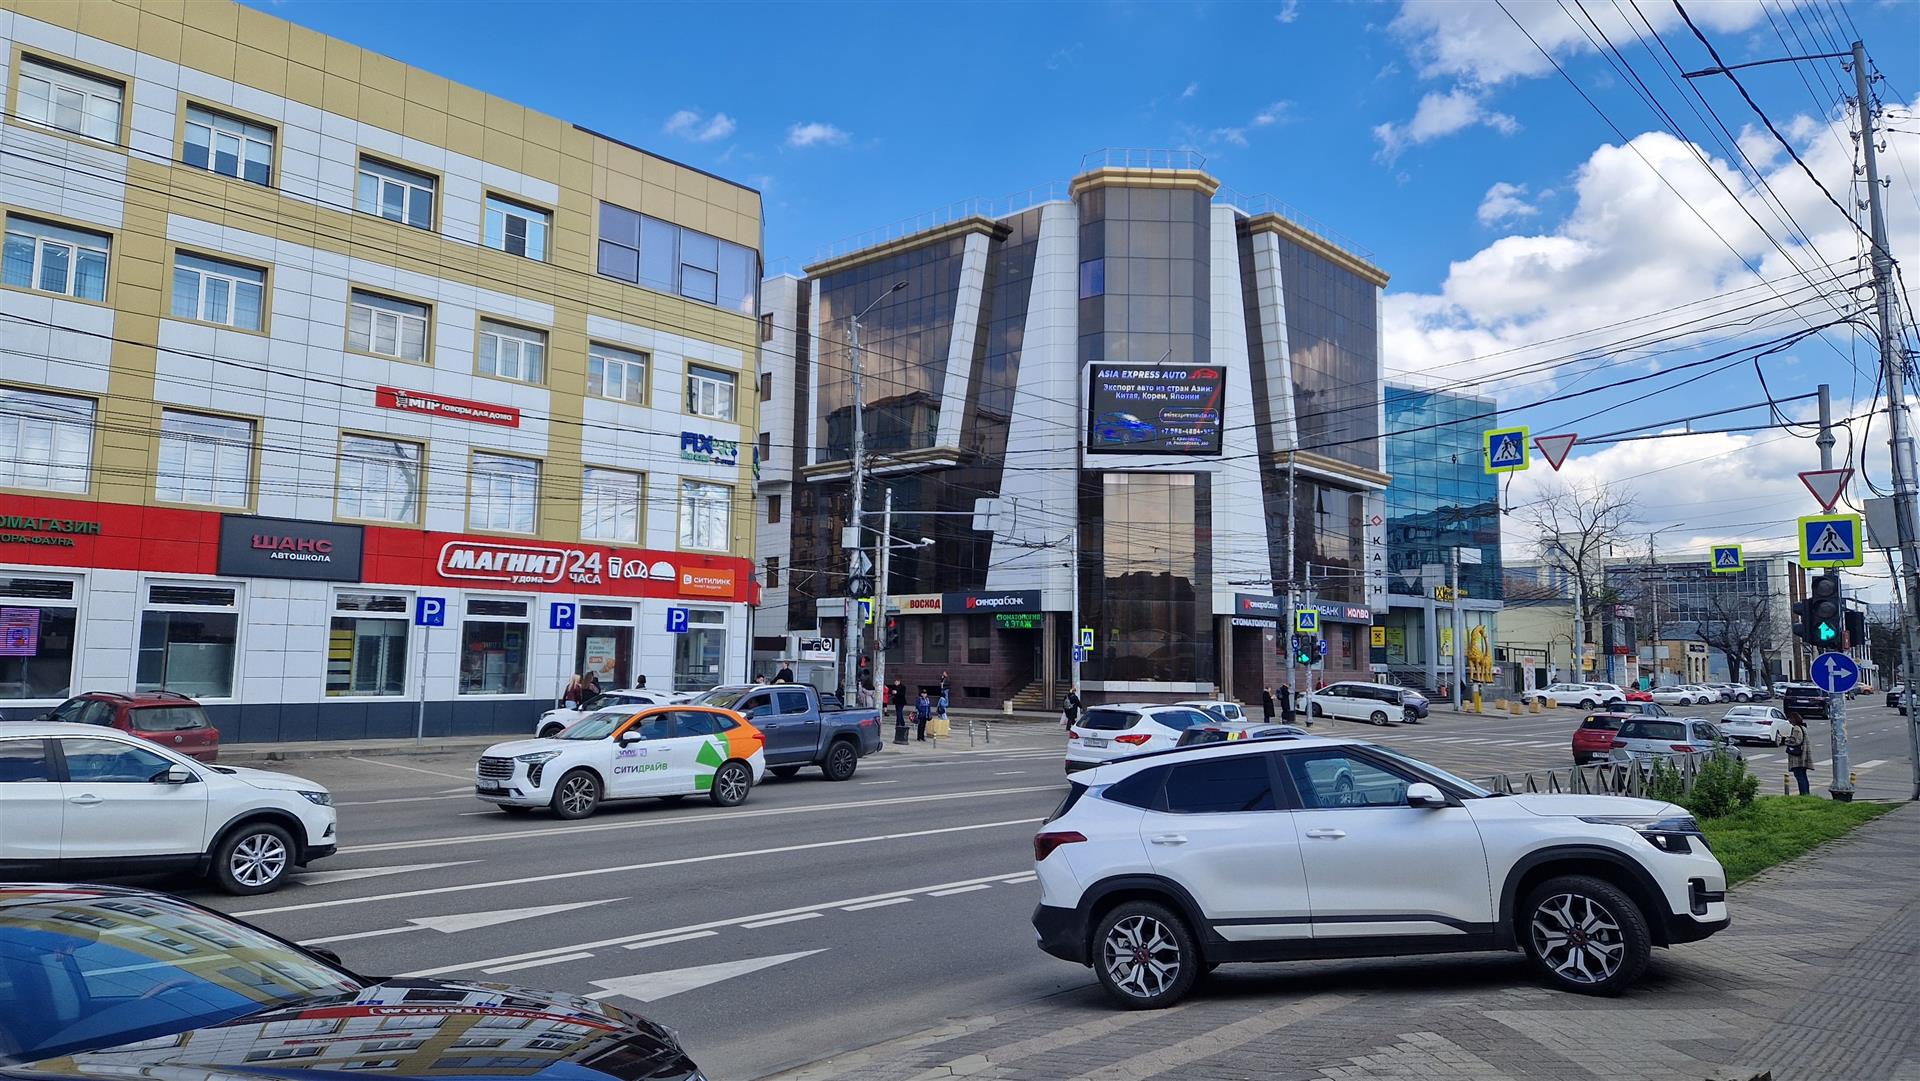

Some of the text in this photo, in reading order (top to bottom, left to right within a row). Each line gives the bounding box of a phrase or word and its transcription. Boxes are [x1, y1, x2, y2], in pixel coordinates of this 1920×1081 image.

[1098, 370, 1187, 379] ASIA EXPRESS AUTO
[1103, 384, 1135, 392] Экспорт
[1167, 385, 1189, 393] стран
[489, 412, 513, 421] дома
[681, 431, 714, 455] FIX
[0, 533, 75, 546] ОРА-ФАУНА
[252, 534, 333, 553] ШАНС
[270, 552, 331, 562] АВТОШКОЛА
[447, 549, 560, 574] МАГНИТ
[569, 551, 602, 574] 24
[519, 575, 544, 584] дома
[569, 573, 602, 584] ЧАСА
[693, 577, 731, 586] СИТИЛИНК
[910, 598, 940, 609] ВОСХОД
[975, 595, 1024, 607] синара банк
[422, 599, 441, 623] P
[556, 605, 571, 627] P
[671, 610, 685, 630] P
[613, 762, 668, 774] СИТИДРАЙВ
